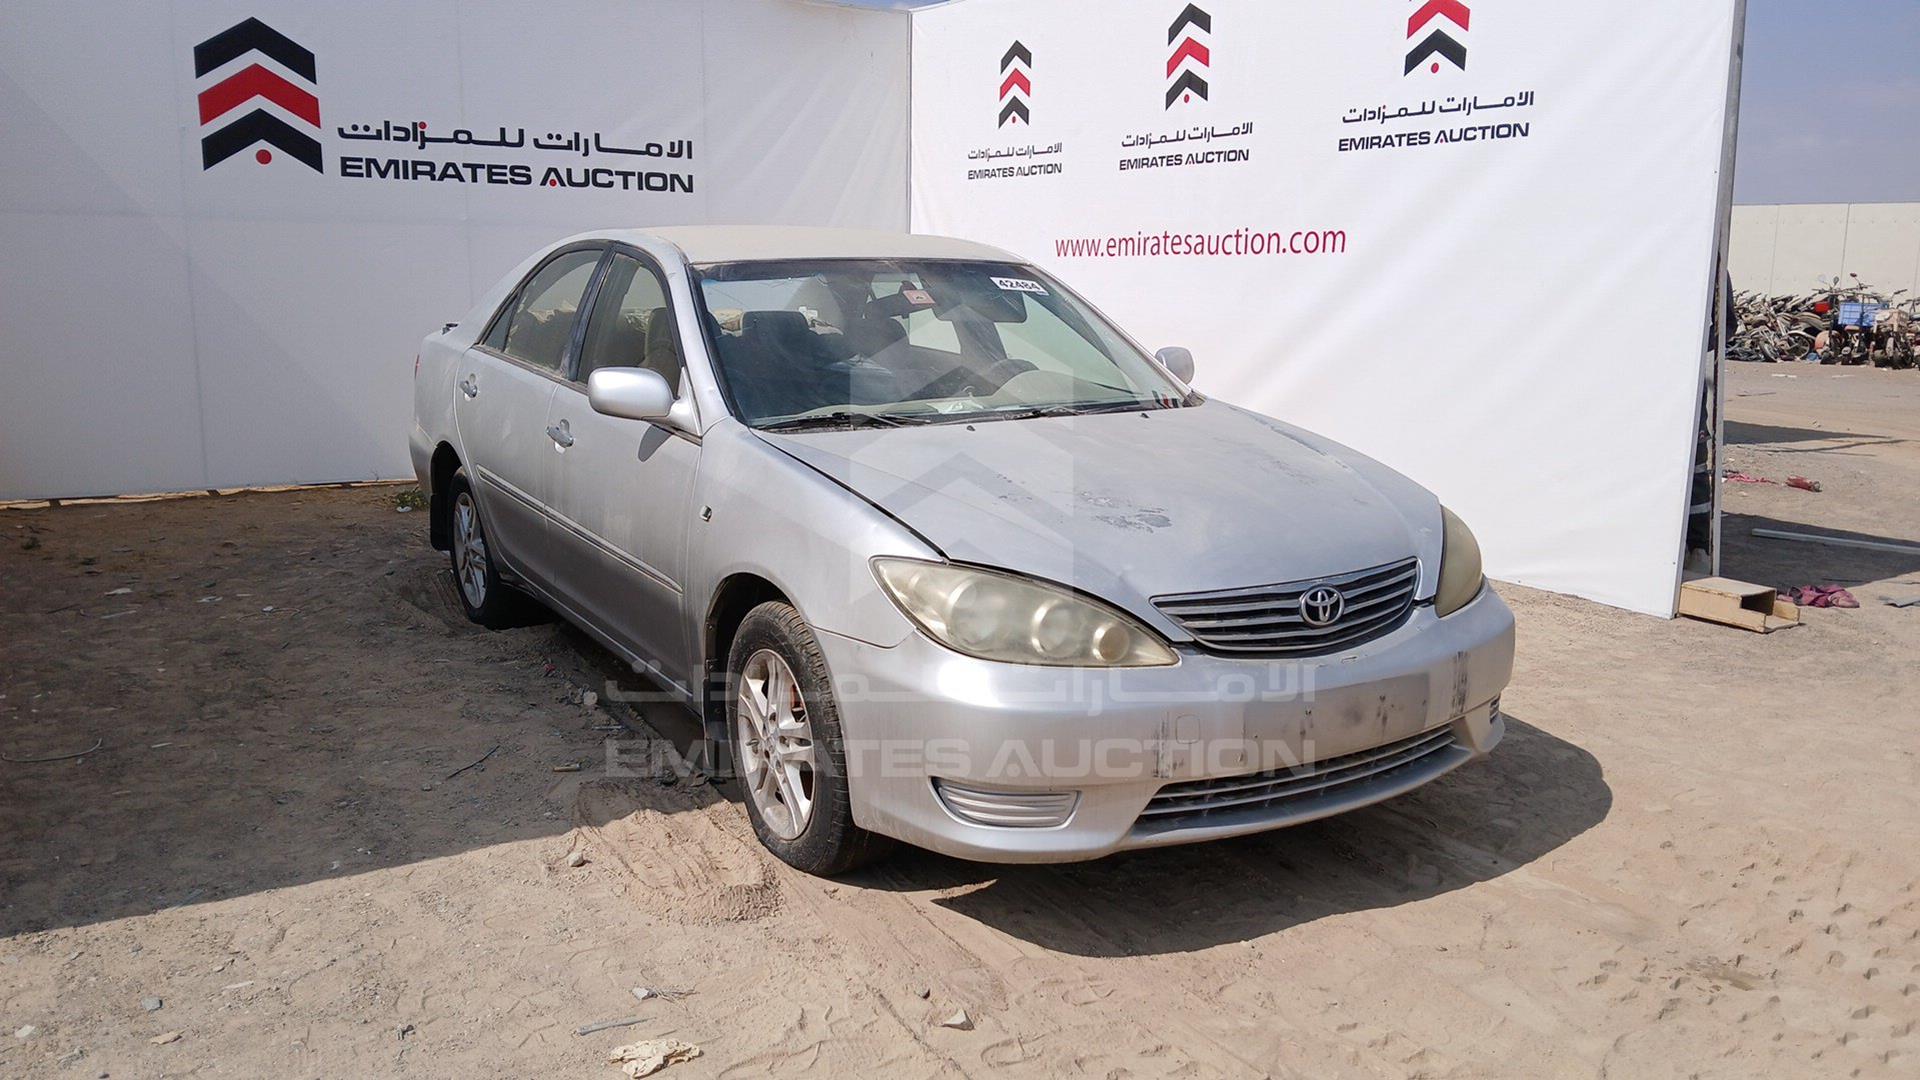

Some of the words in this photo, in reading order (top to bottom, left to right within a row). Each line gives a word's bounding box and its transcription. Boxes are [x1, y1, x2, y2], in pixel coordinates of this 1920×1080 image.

[1338, 131, 1432, 151] EMIRATES
[1434, 122, 1530, 145] AUCTION
[967, 166, 1015, 180] EMIRATES
[1016, 162, 1063, 177] AUCTION
[1119, 154, 1183, 170] EMIRATES
[1185, 149, 1250, 165] AUCTION
[340, 156, 532, 186] EMIRATES
[539, 166, 694, 193] AUCTION
[1056, 227, 1347, 258] www.emiratesauction.com
[998, 279, 1041, 291] 42484
